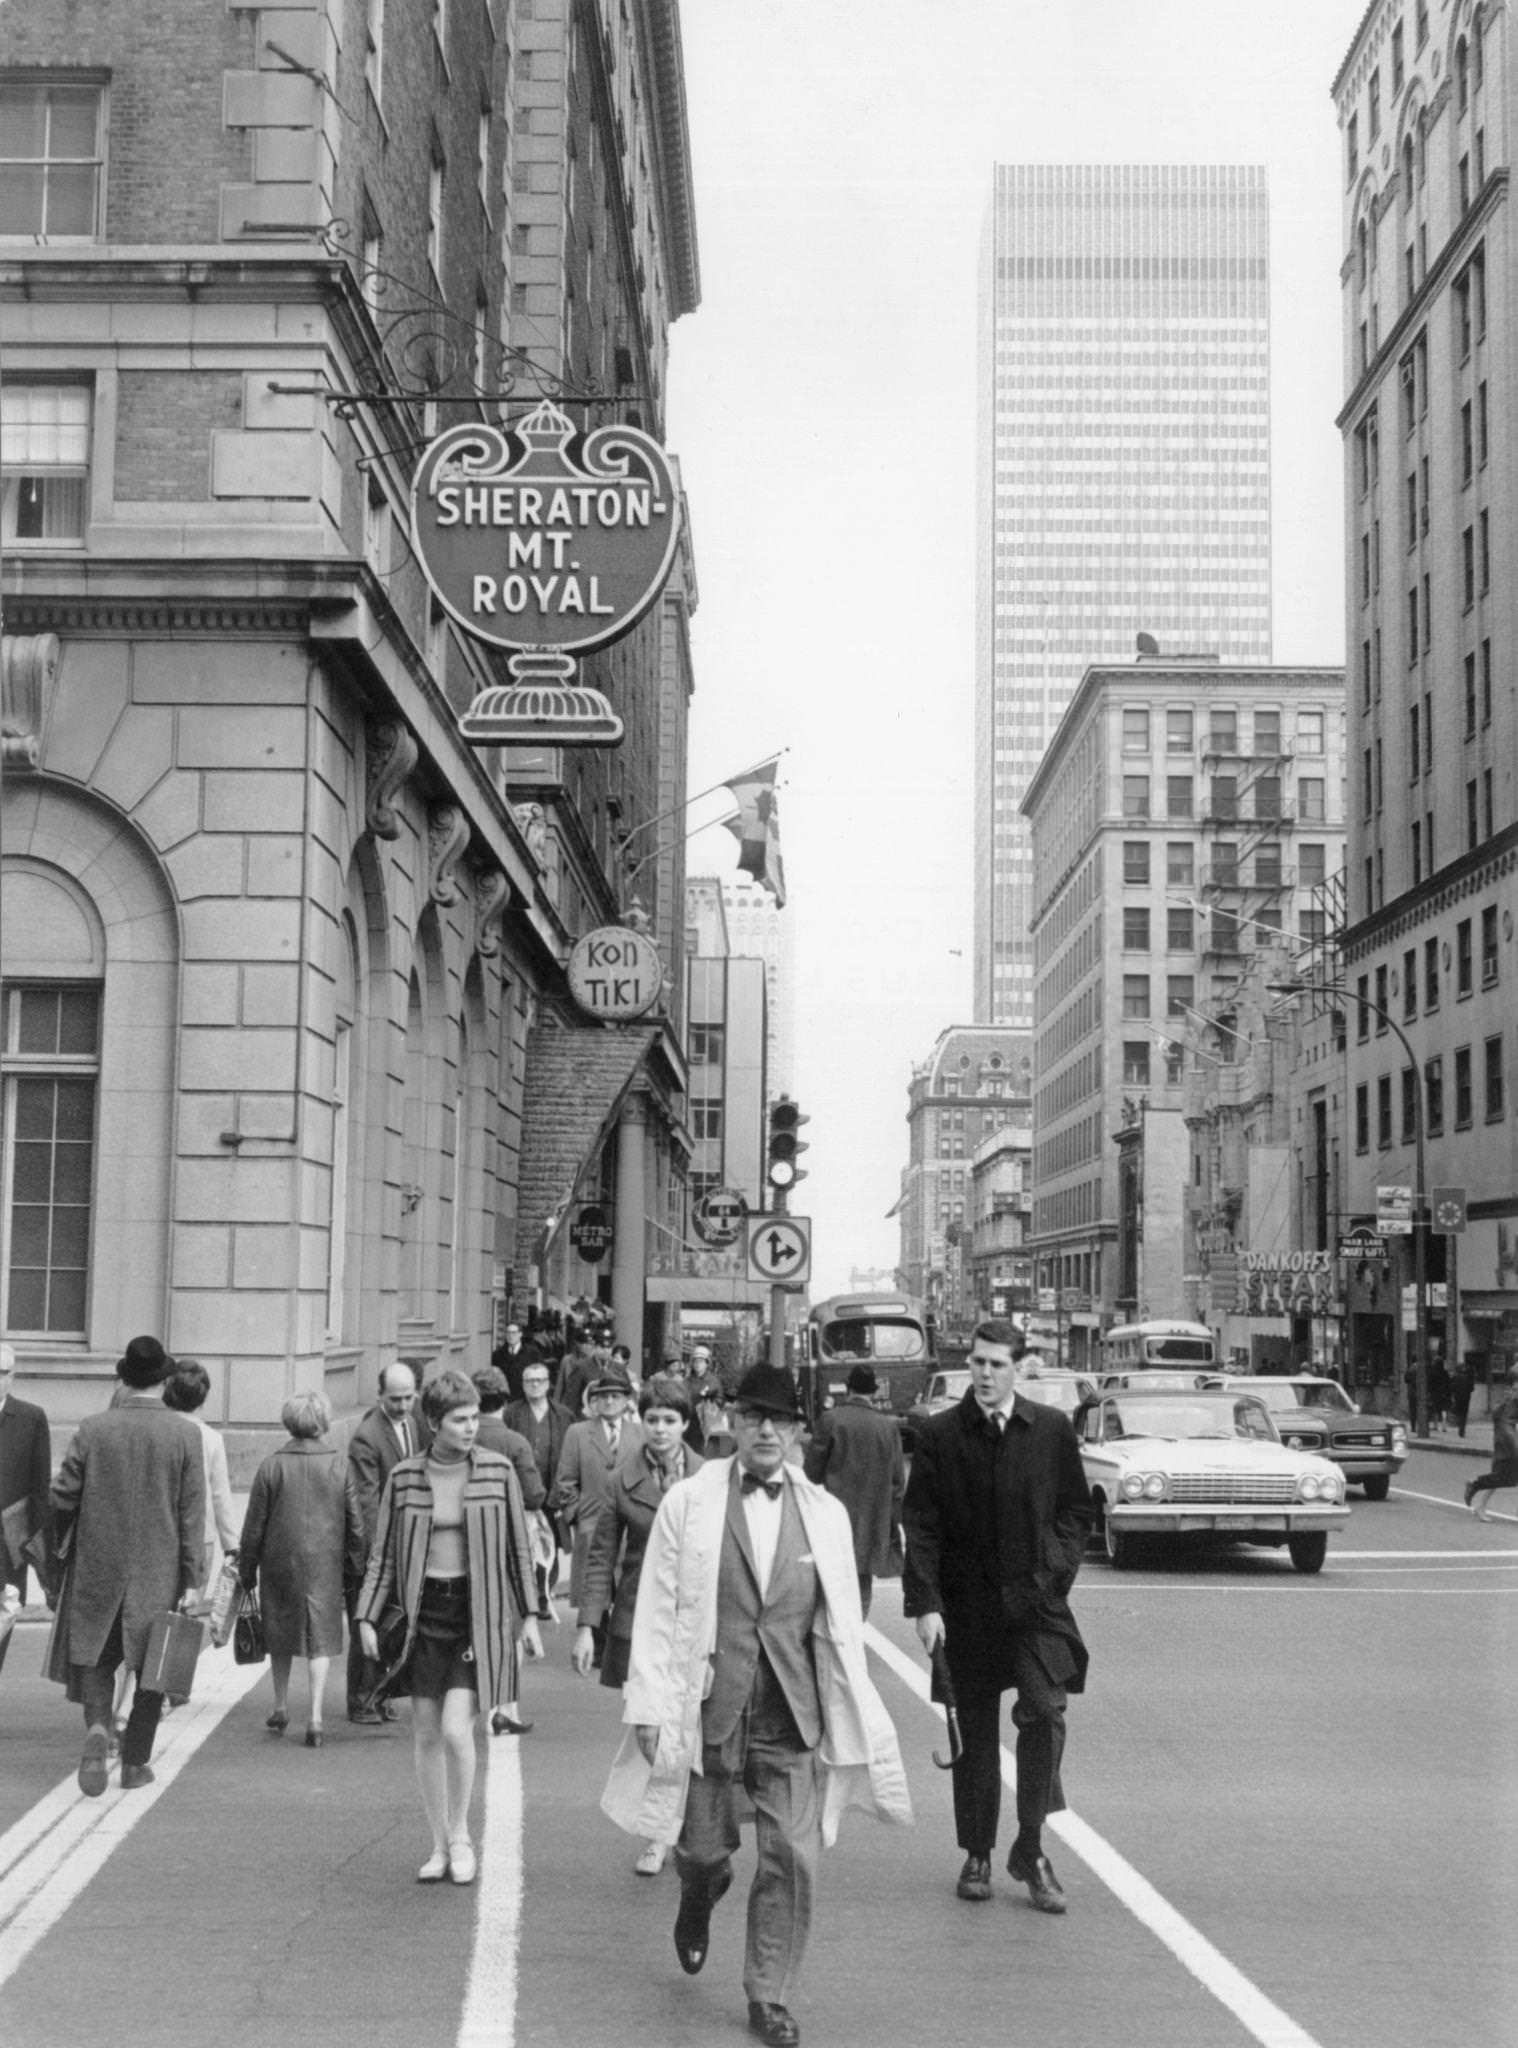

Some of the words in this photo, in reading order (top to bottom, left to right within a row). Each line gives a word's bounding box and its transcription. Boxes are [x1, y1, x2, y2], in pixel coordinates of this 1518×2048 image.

[437, 487, 667, 526] SHERATON-
[508, 531, 580, 570] MT.
[472, 574, 615, 613] ROYAL
[1248, 1272, 1333, 1299] STEAK
